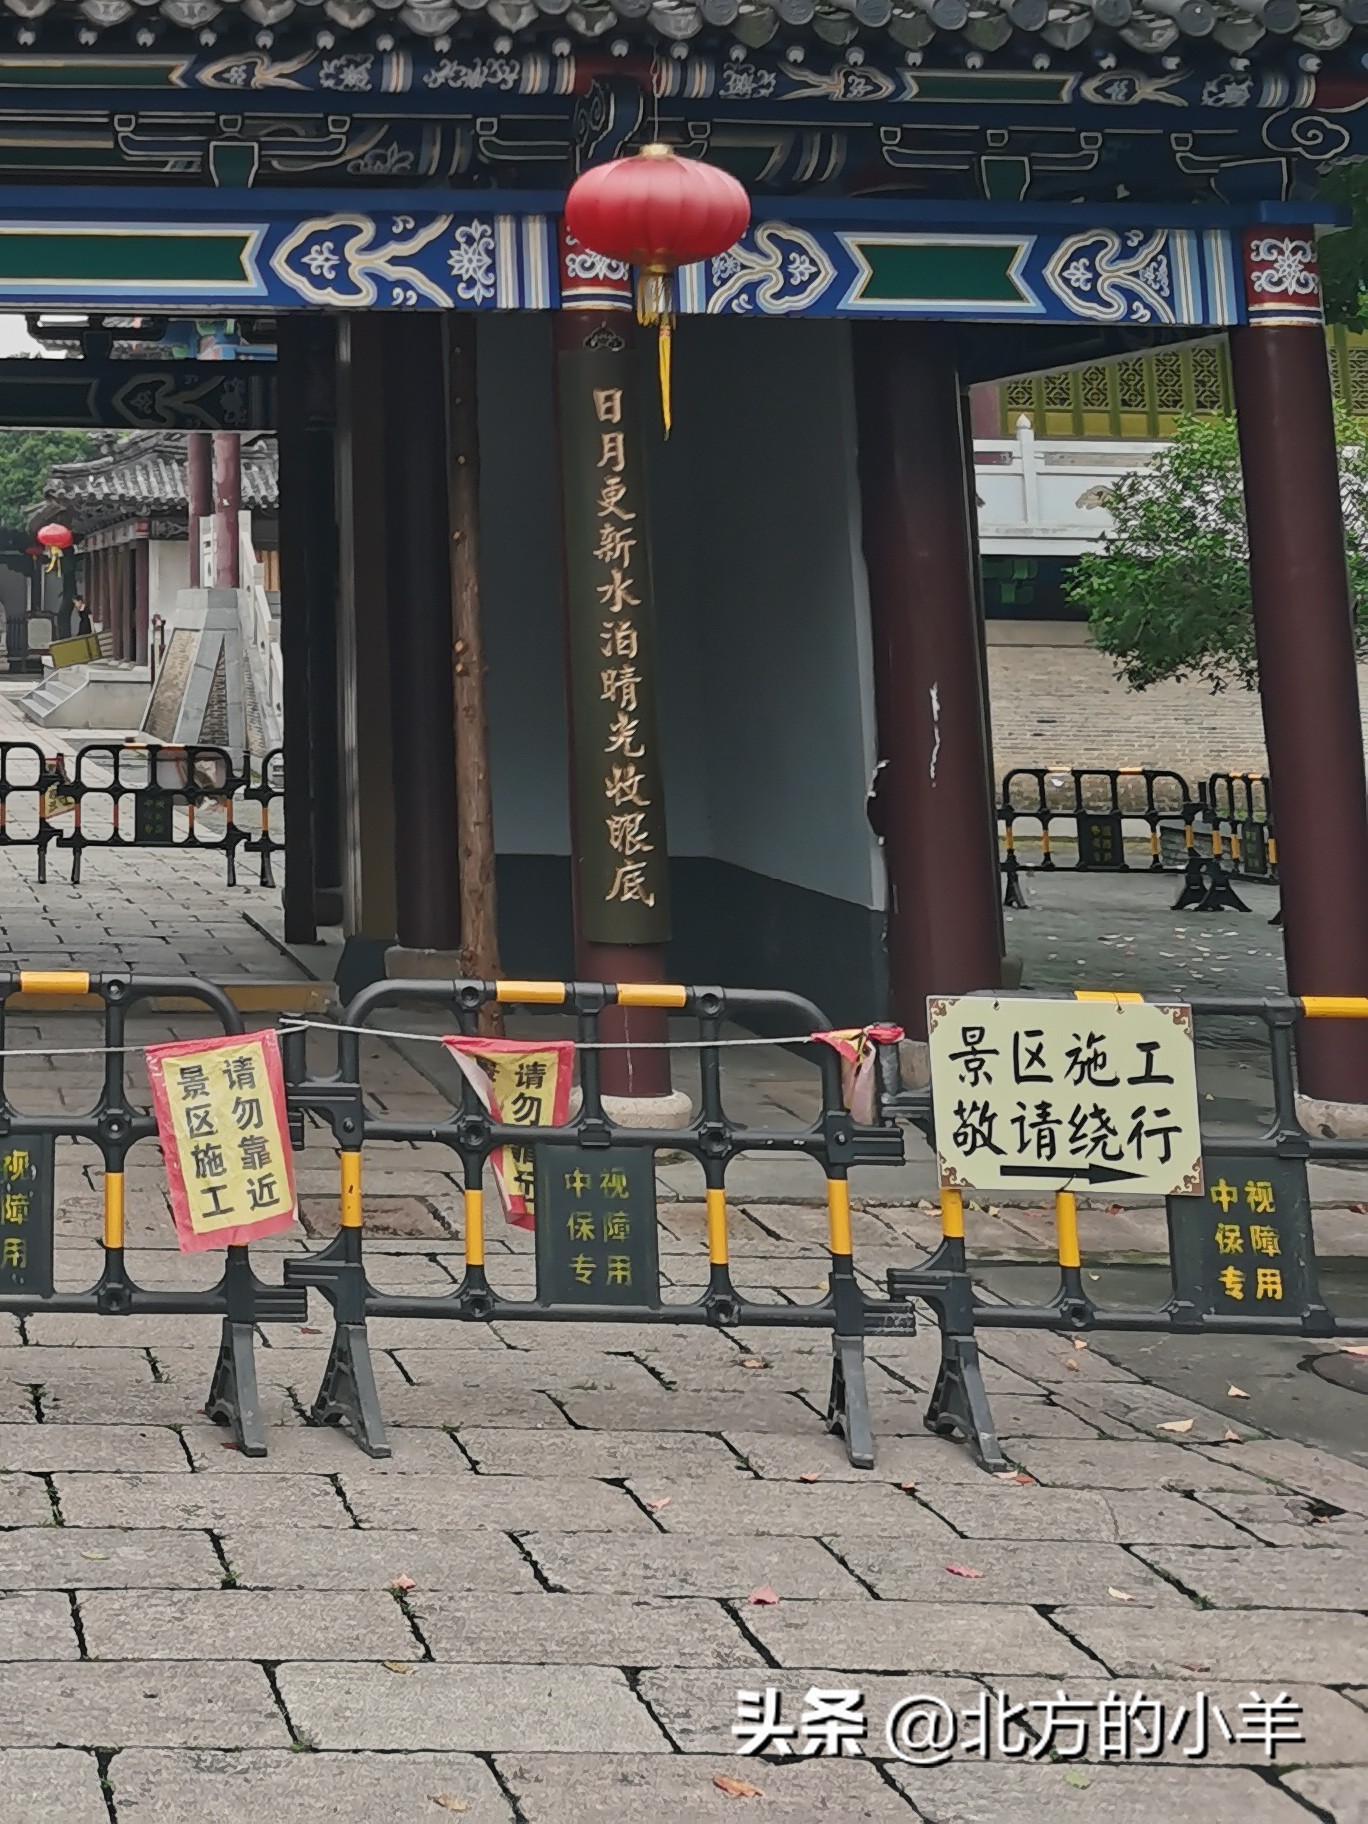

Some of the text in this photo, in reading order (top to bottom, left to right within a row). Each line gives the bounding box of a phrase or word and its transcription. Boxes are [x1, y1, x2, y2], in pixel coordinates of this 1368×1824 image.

[948, 1026, 1175, 1087] 景区施工
[176, 1064, 234, 1220] 景区施工
[222, 1056, 281, 1212] 请勿靠近
[952, 1100, 1182, 1164] 敬请绕行
[564, 1167, 630, 1200] 中视
[1210, 1178, 1276, 1214] 中视
[566, 1211, 631, 1243] 保障
[1214, 1222, 1282, 1257] 保障
[569, 1254, 631, 1287] 专用
[1217, 1266, 1283, 1301] 专用
